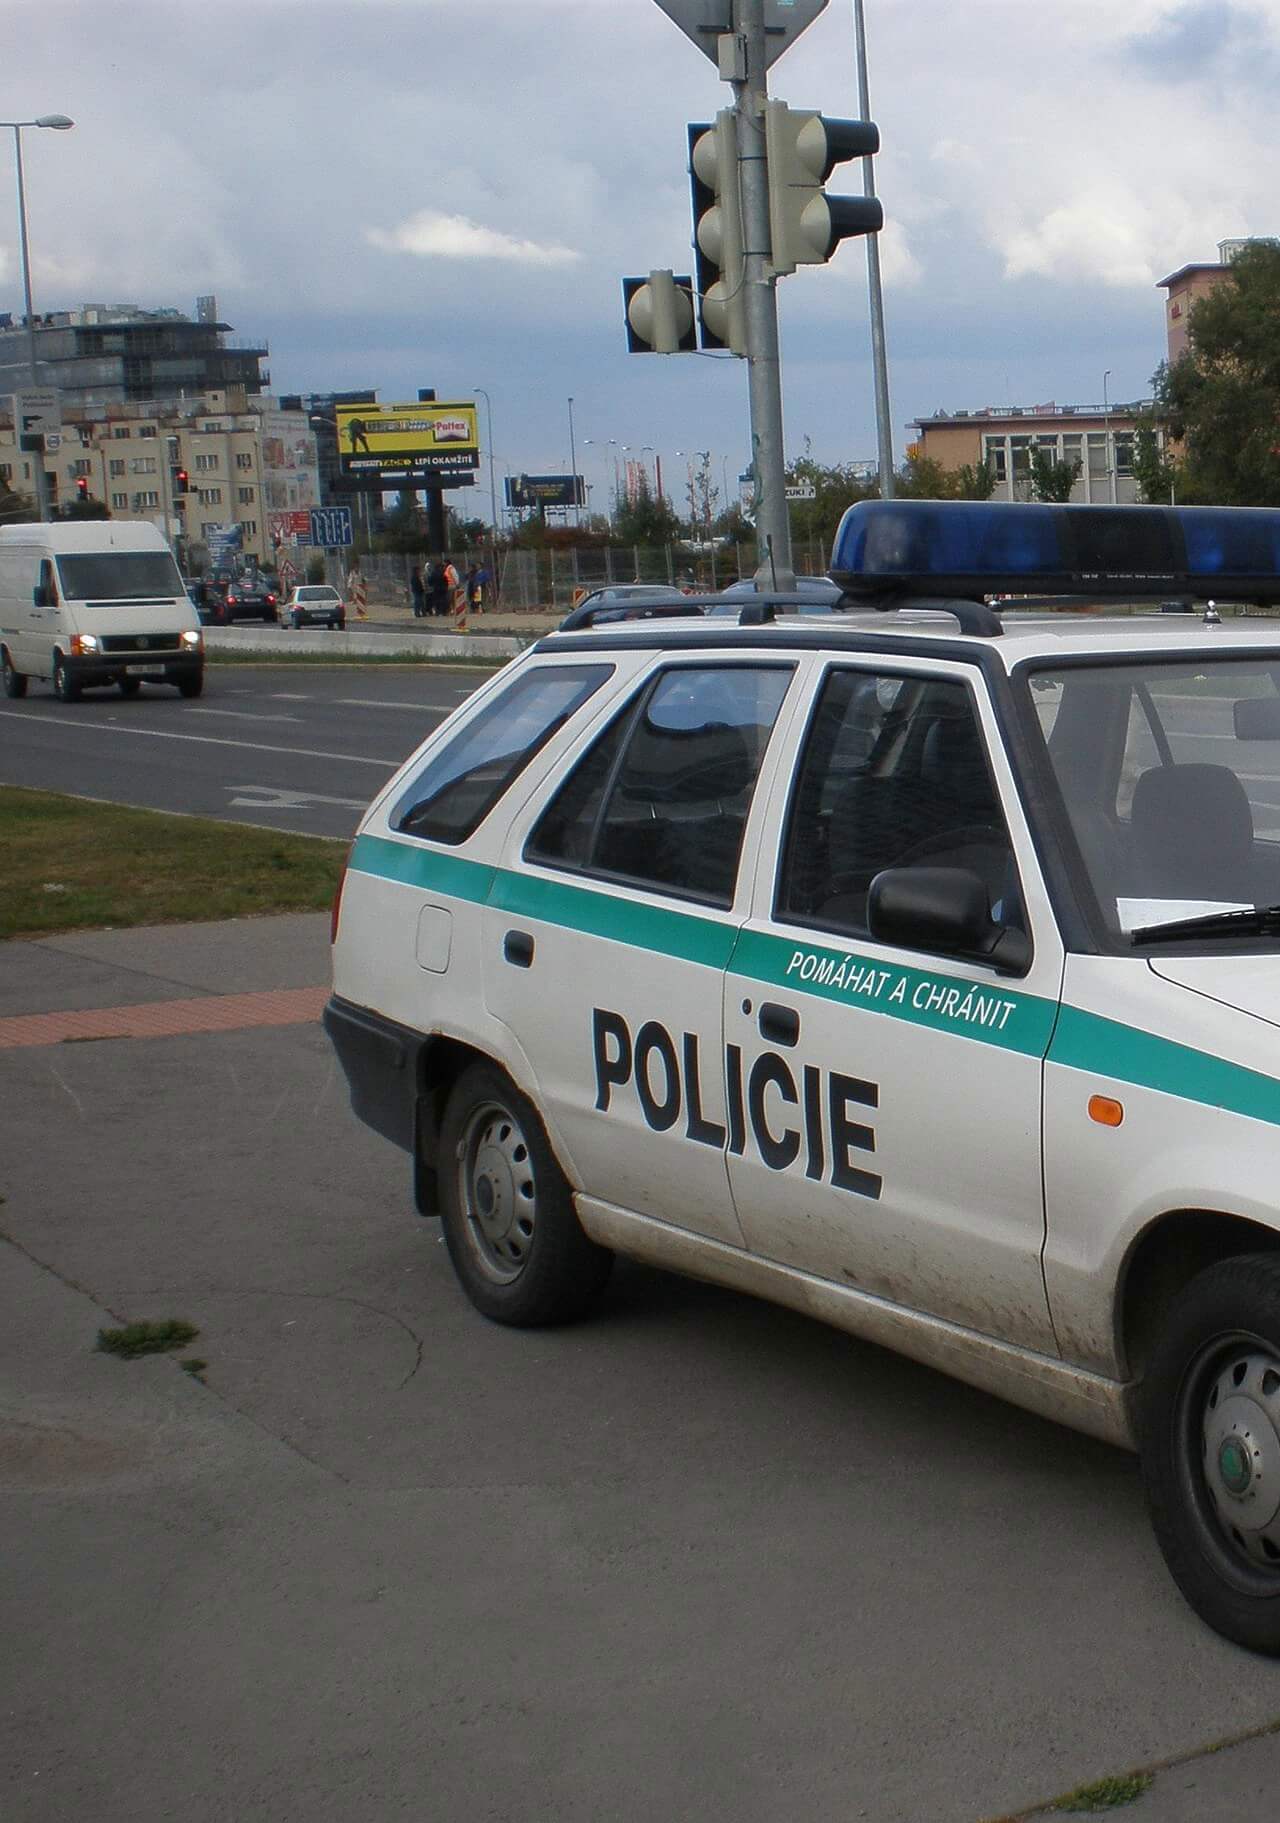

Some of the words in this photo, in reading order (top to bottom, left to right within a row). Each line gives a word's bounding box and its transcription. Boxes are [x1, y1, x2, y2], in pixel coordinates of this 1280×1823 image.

[786, 950, 890, 998] POMÁHAT
[889, 973, 907, 1004] A
[911, 980, 1017, 1030] CHRÁNIT
[592, 1006, 884, 1202] POLICIE
